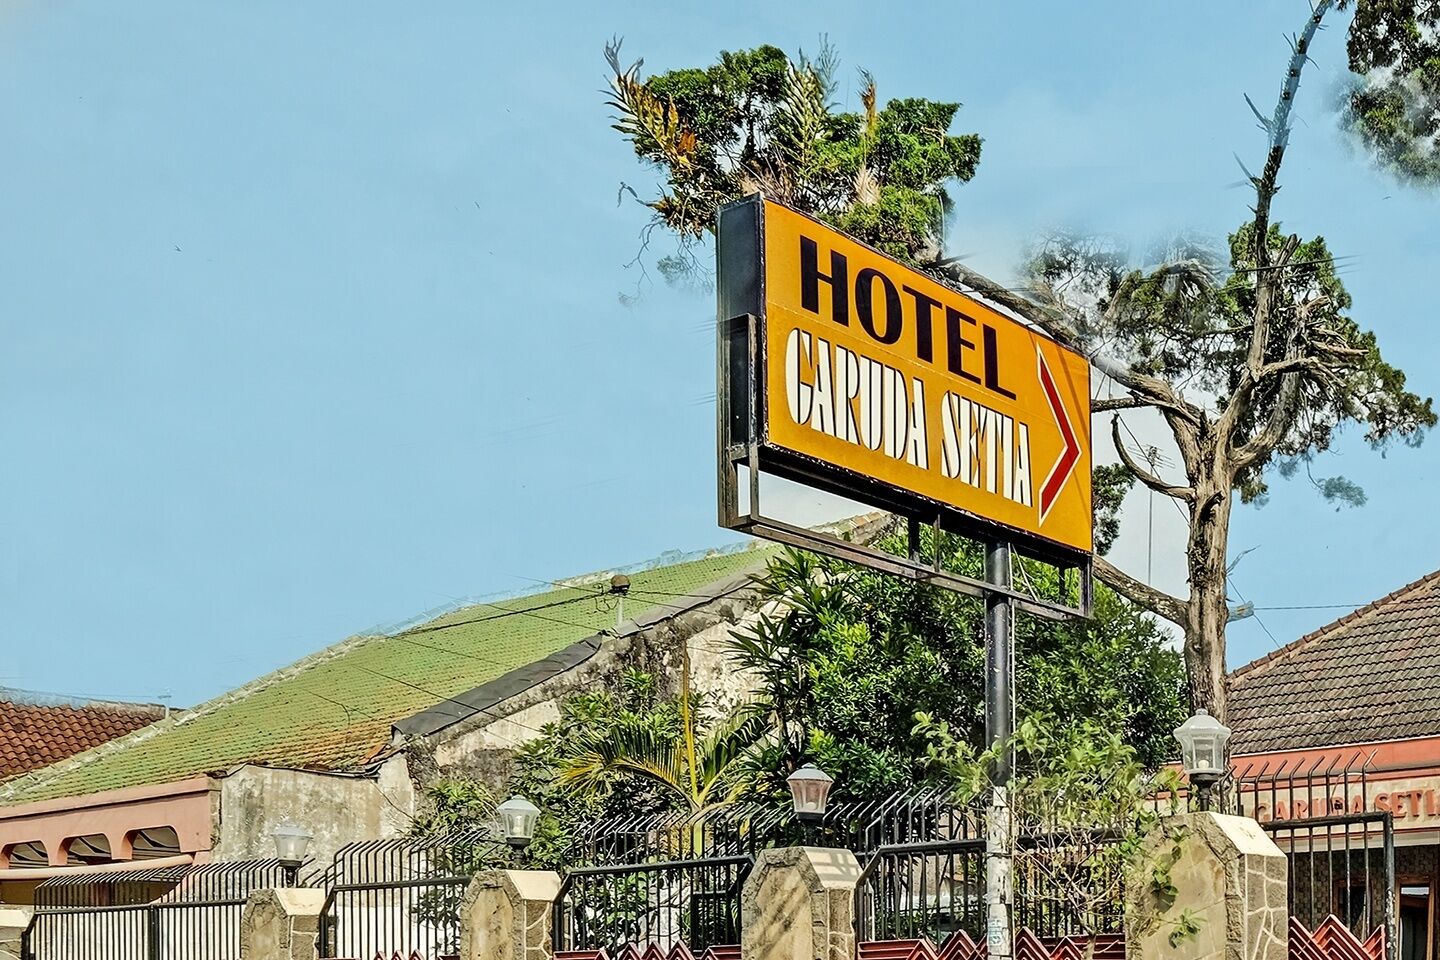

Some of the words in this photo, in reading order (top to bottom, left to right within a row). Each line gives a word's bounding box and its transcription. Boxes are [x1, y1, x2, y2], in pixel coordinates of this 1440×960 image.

[799, 234, 1017, 401] HOTEL
[785, 327, 930, 471] GARUDA
[941, 389, 1033, 508] SETIA
